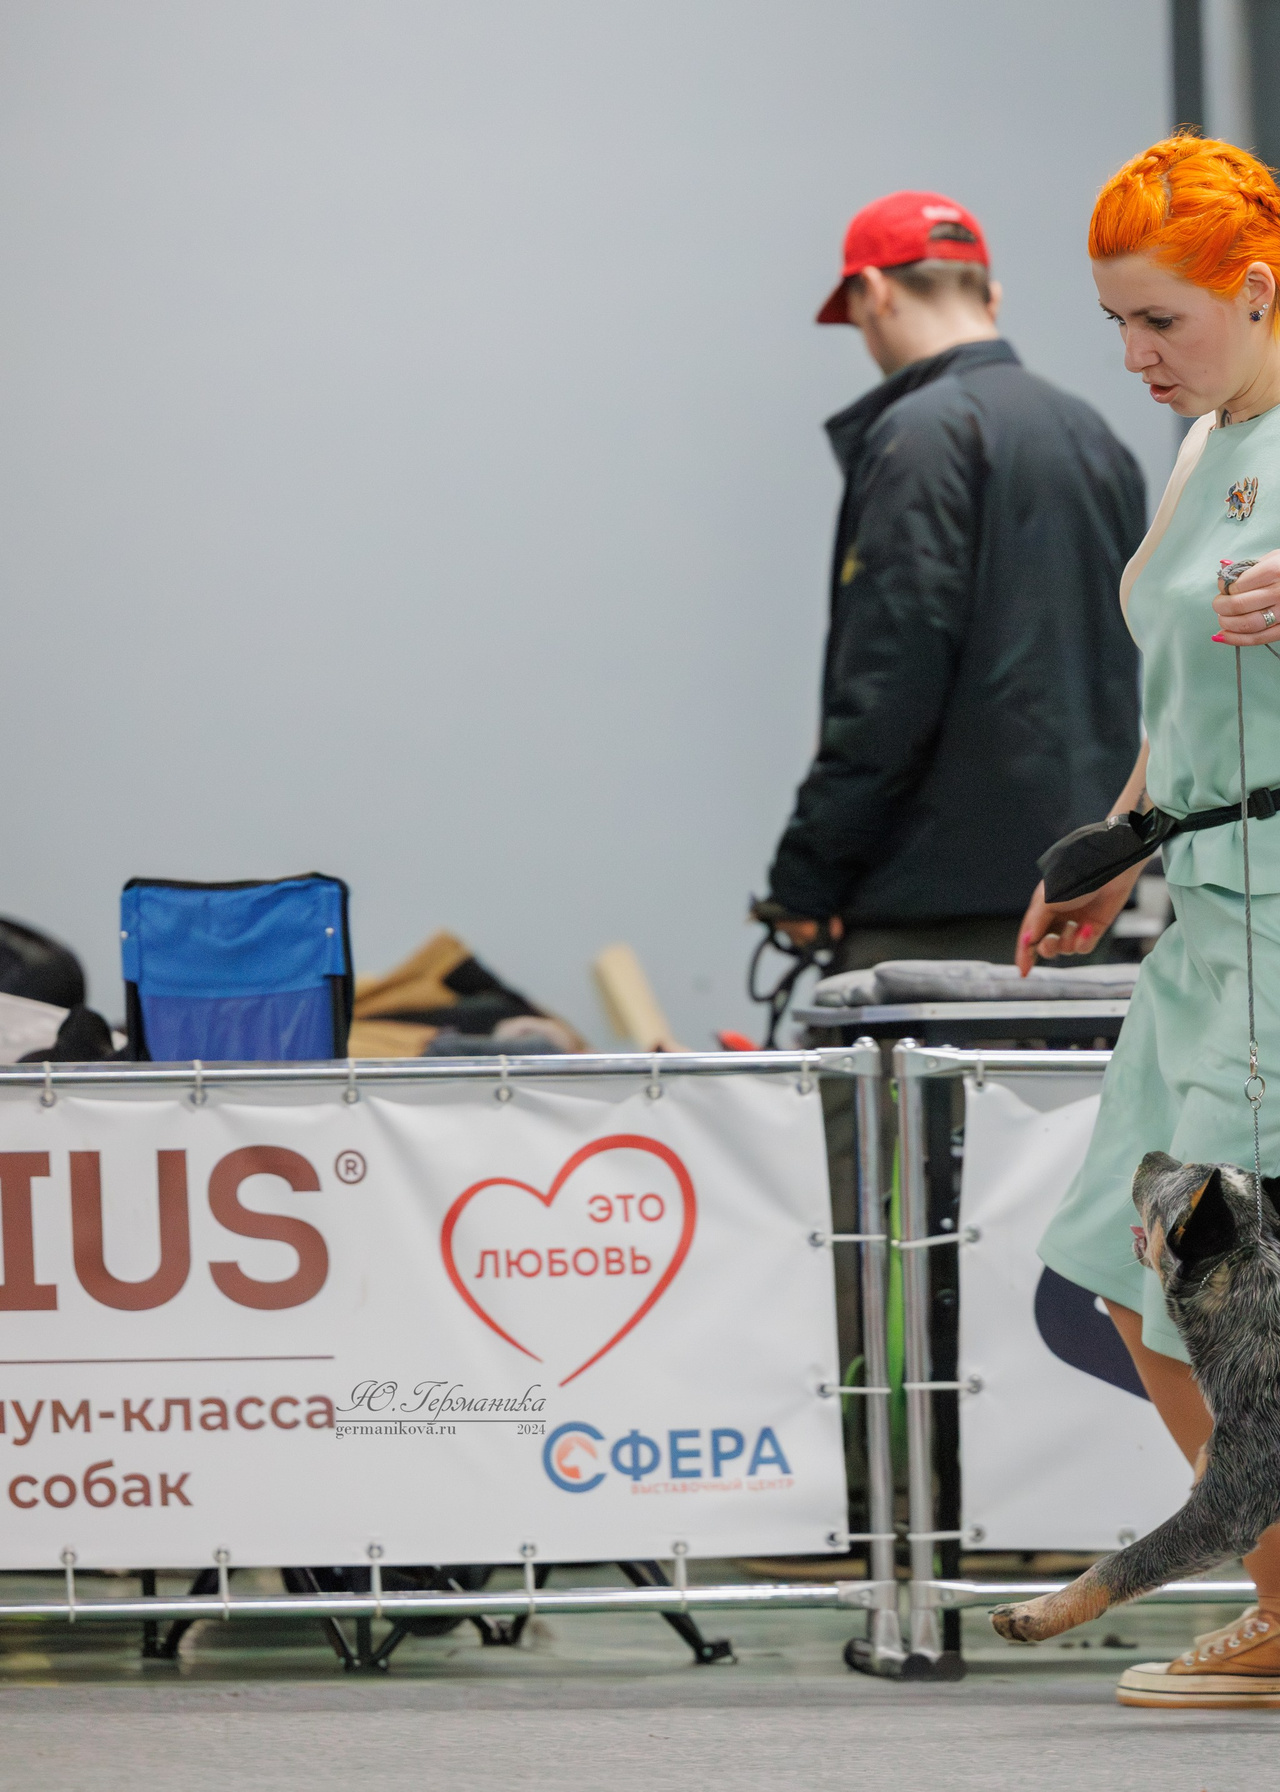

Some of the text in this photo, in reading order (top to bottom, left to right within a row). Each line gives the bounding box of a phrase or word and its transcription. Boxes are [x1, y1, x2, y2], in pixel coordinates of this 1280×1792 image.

[588, 1193, 665, 1223] ЭТО
[475, 1246, 652, 1279] ЛЮБОВЬ
[0, 1395, 335, 1446] ум-класса
[542, 1421, 792, 1493] СФЕРА
[8, 1459, 194, 1509] собак
